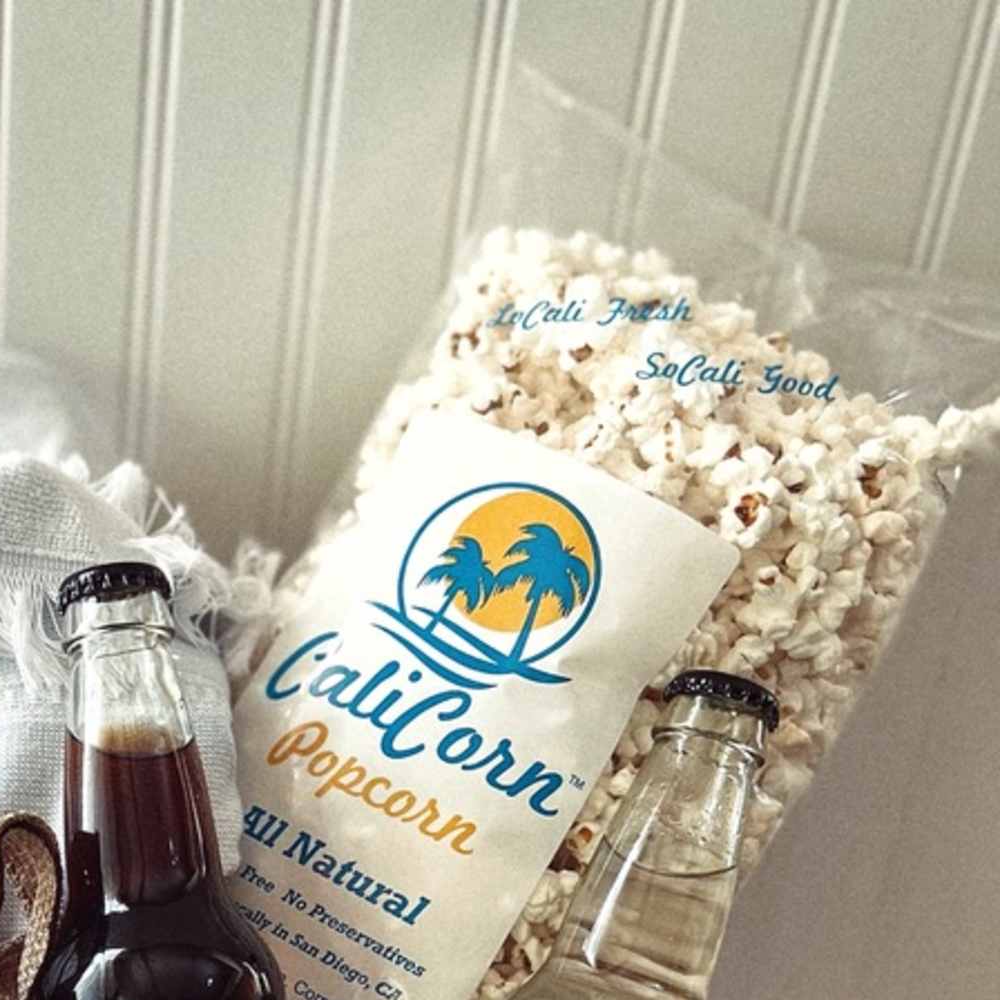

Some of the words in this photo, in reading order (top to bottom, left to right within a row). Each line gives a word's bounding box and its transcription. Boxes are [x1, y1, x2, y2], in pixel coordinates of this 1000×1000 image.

[597, 297, 693, 326] Fresh
[636, 352, 744, 387] SoCali
[757, 364, 840, 401] Good
[265, 631, 560, 817] CaliCorn
[266, 720, 478, 856] Popcorn
[240, 864, 276, 894] Free
[281, 888, 307, 912] No
[308, 902, 427, 979] Preservatives
[243, 805, 289, 848] All
[282, 831, 431, 926] Natural
[235, 901, 272, 934] cally
[272, 923, 289, 942] in
[289, 932, 320, 958] San
[319, 950, 371, 990] Diego,
